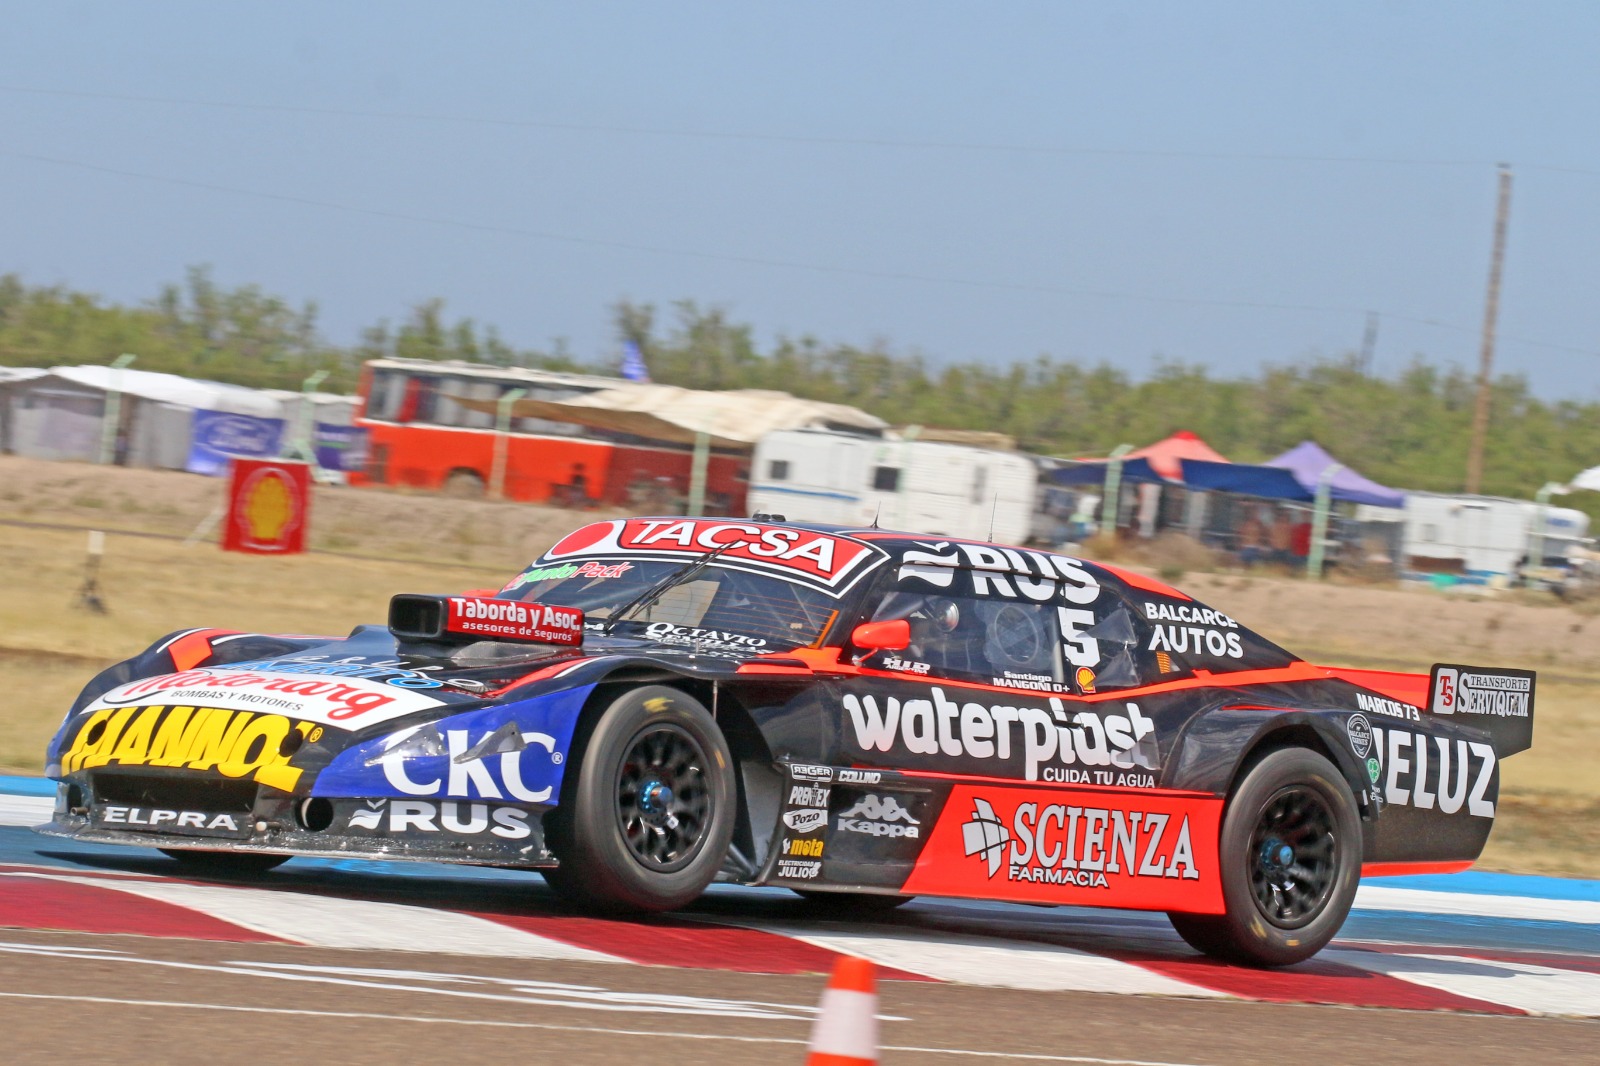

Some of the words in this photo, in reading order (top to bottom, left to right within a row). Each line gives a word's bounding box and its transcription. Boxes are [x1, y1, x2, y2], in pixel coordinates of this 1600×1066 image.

[630, 520, 836, 573] TACSA
[956, 544, 1101, 605] RUS
[451, 597, 527, 623] Taborda
[529, 609, 541, 629] y
[543, 607, 581, 631] Asoc.
[1144, 602, 1239, 628] BALCARCE
[462, 621, 516, 635] asesores
[518, 626, 532, 637] de
[533, 629, 572, 642] seguros
[646, 622, 767, 647] OCTAVIO
[1058, 606, 1101, 668] 5
[1147, 624, 1244, 659] AUTOS
[992, 677, 1052, 692] MANGONI
[1003, 670, 1053, 683] Santiago
[1471, 675, 1529, 690] TRANSPORTE
[170, 690, 224, 700] BOMBAS
[226, 692, 239, 702] Y
[241, 693, 305, 712] MOTORES
[1356, 692, 1404, 718] MARCOS
[1402, 701, 1421, 721] 73
[842, 687, 1161, 781] waterplast
[382, 727, 557, 802] CKC
[1042, 767, 1090, 784] CUIDA
[1094, 771, 1113, 786] TU
[1117, 773, 1156, 788] AGUA
[103, 806, 238, 831] ELPRA
[389, 800, 532, 839] RUS
[837, 818, 919, 839] Kappa
[1009, 801, 1200, 880] SCIENZA
[778, 866, 810, 879] JULIO
[1008, 865, 1109, 888] FARMACIA
